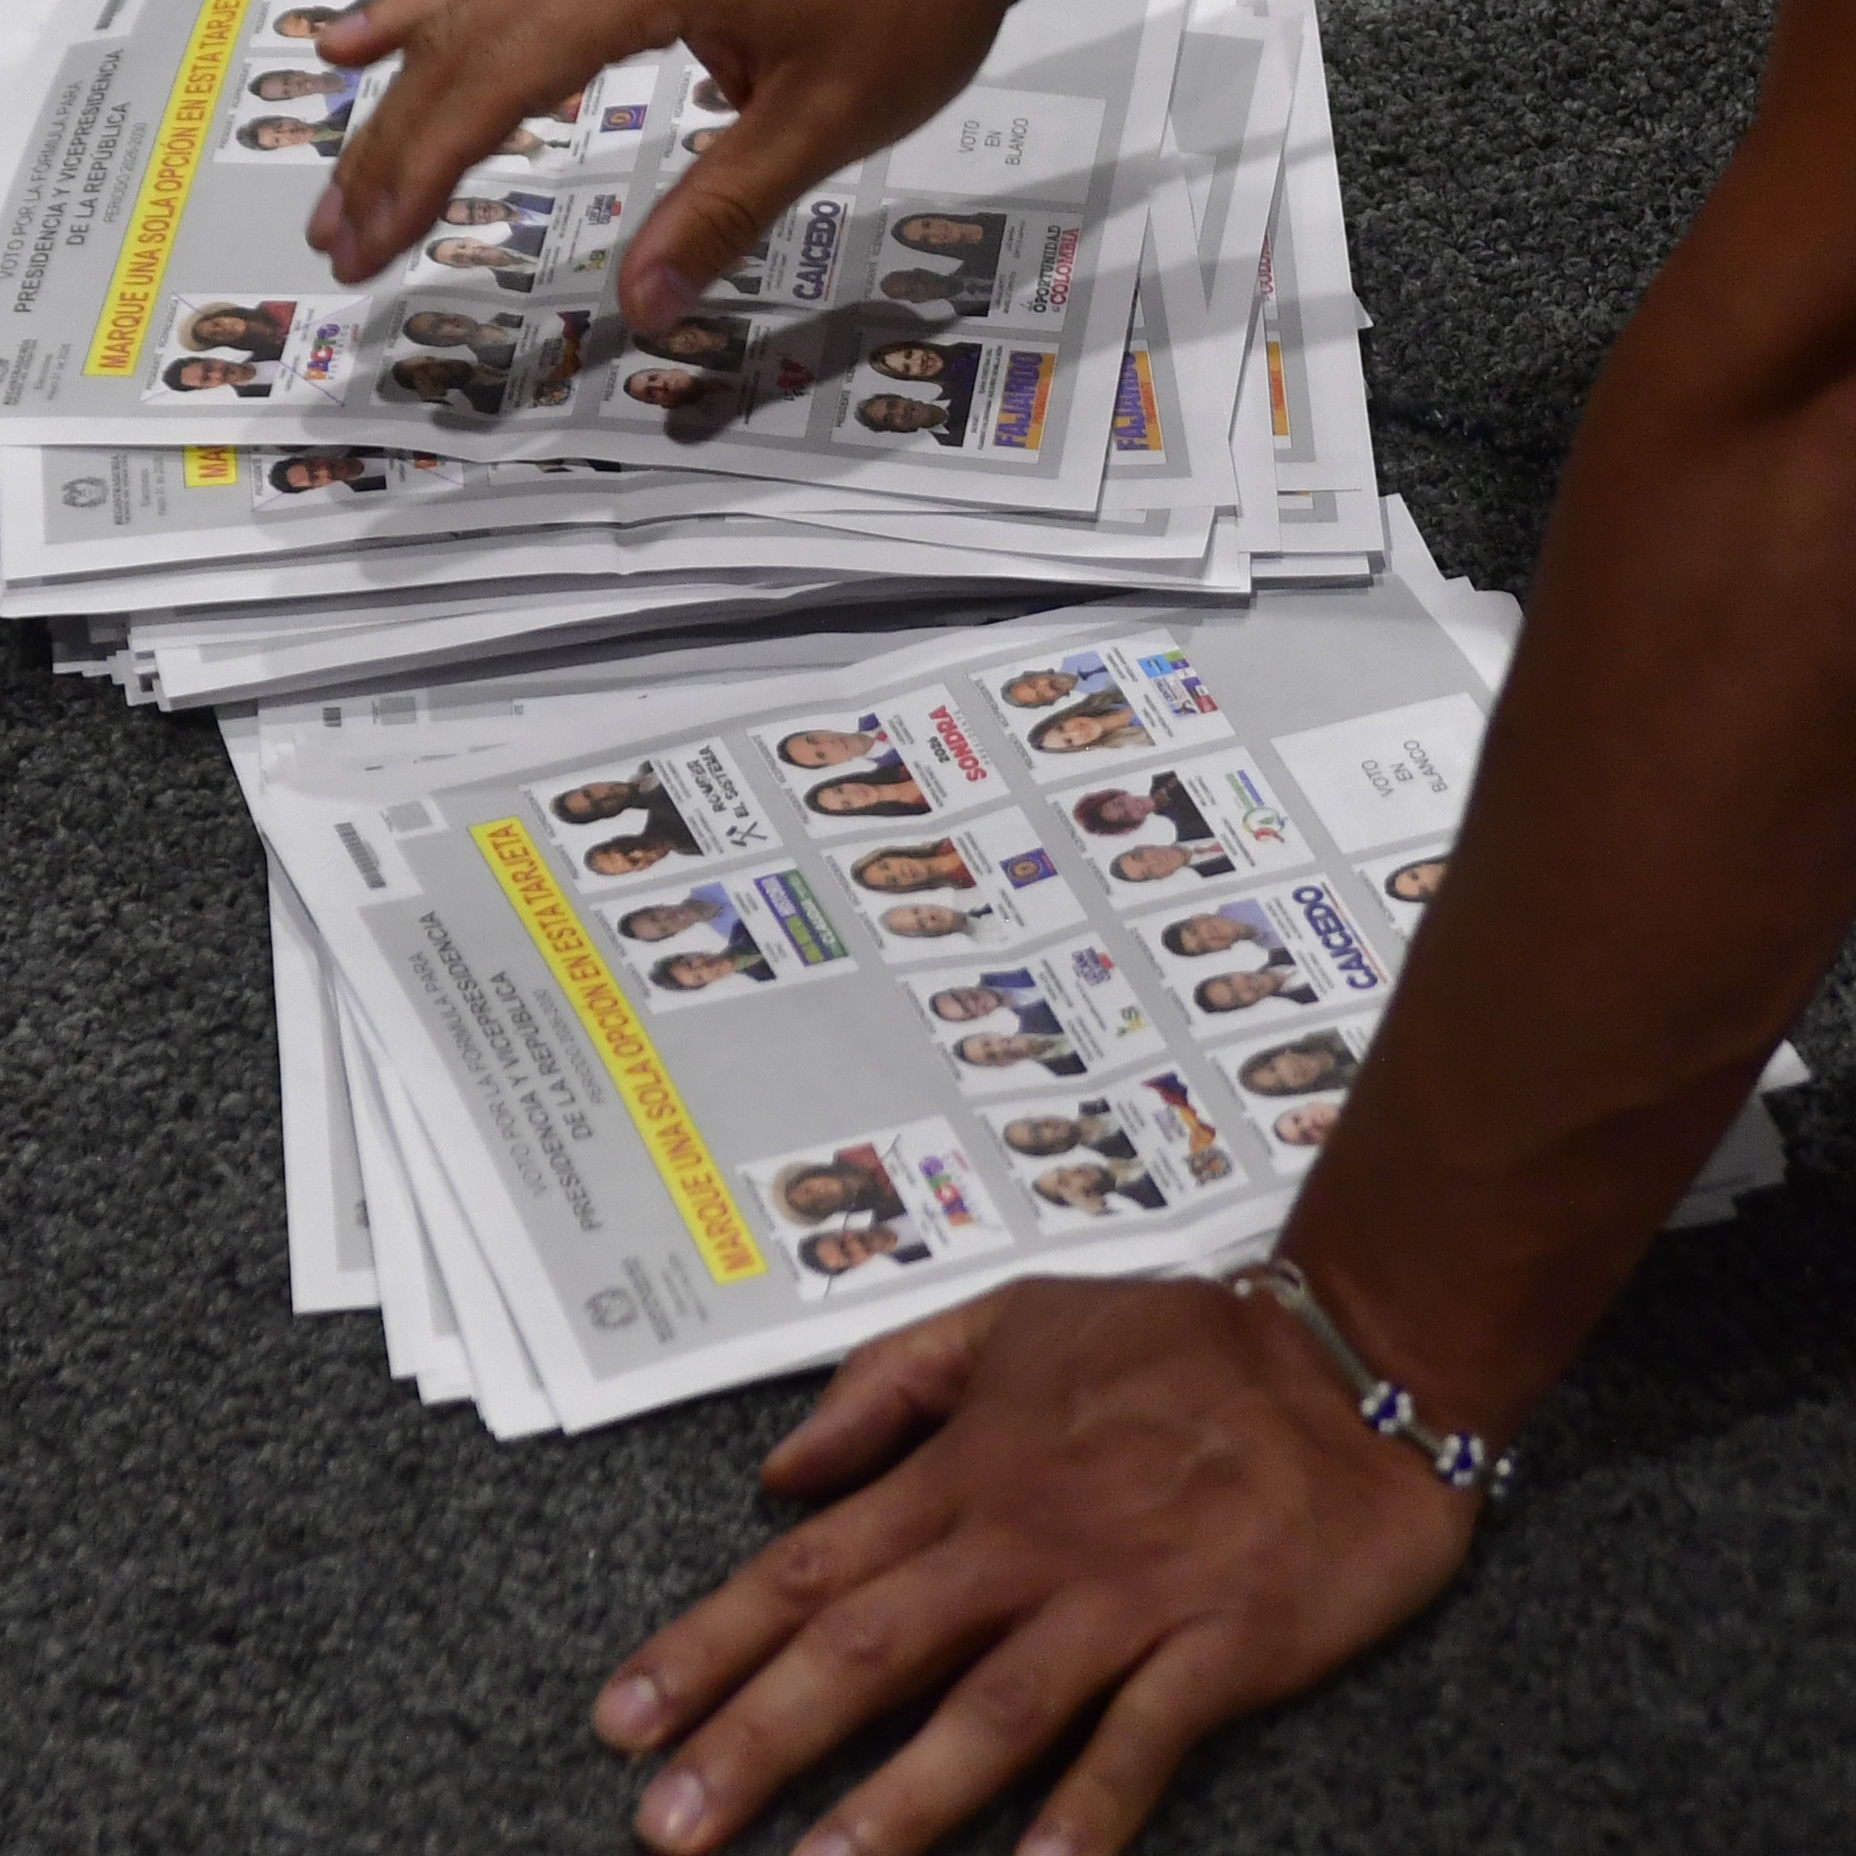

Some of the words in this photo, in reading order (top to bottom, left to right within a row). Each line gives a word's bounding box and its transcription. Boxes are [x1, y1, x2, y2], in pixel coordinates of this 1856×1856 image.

[183, 50, 225, 95] ESTA
[55, 48, 124, 181] VICEPRESIDENCIA
[175, 98, 209, 121] EN
[80, 101, 130, 192] REPÚBLICA
[151, 125, 201, 192] OPCIÓN
[957, 118, 980, 155] VOTO
[983, 129, 1002, 148] EN
[1004, 116, 1029, 166] BLANCO
[22, 183, 44, 201] LA
[51, 186, 71, 195] Y
[73, 197, 98, 218] LA
[11, 206, 37, 235] POR
[64, 224, 89, 245] DE
[136, 195, 179, 243] SOLA
[11, 201, 68, 312] PRESIDENCIA
[123, 248, 163, 285] UNA
[790, 199, 843, 300] CAICEDO
[1032, 224, 1061, 313] OPORTUNIDAD
[1048, 226, 1079, 305] COLOMBIA
[95, 290, 150, 368] MARQUE
[992, 350, 1043, 448] FAJARDO
[924, 704, 989, 783] SONDRA
[1400, 738, 1449, 793] BLANCO
[1358, 758, 1397, 797] VOTO
[1388, 762, 1414, 782] EN
[483, 823, 556, 906] TARJETA
[530, 902, 585, 954] ESTA
[1286, 882, 1382, 991] CAICEDO
[405, 950, 443, 994] PARA
[414, 909, 522, 1070] VICEPRESIDENCIA
[560, 950, 602, 983] EN
[506, 1072, 531, 1088] Y
[544, 1076, 577, 1106] LA
[618, 1057, 679, 1122] SOLA
[560, 1109, 594, 1141] DE
[650, 1120, 705, 1173] UNA
[514, 1089, 604, 1233] PRESIDENCIA
[677, 1170, 759, 1273] MARQUE
